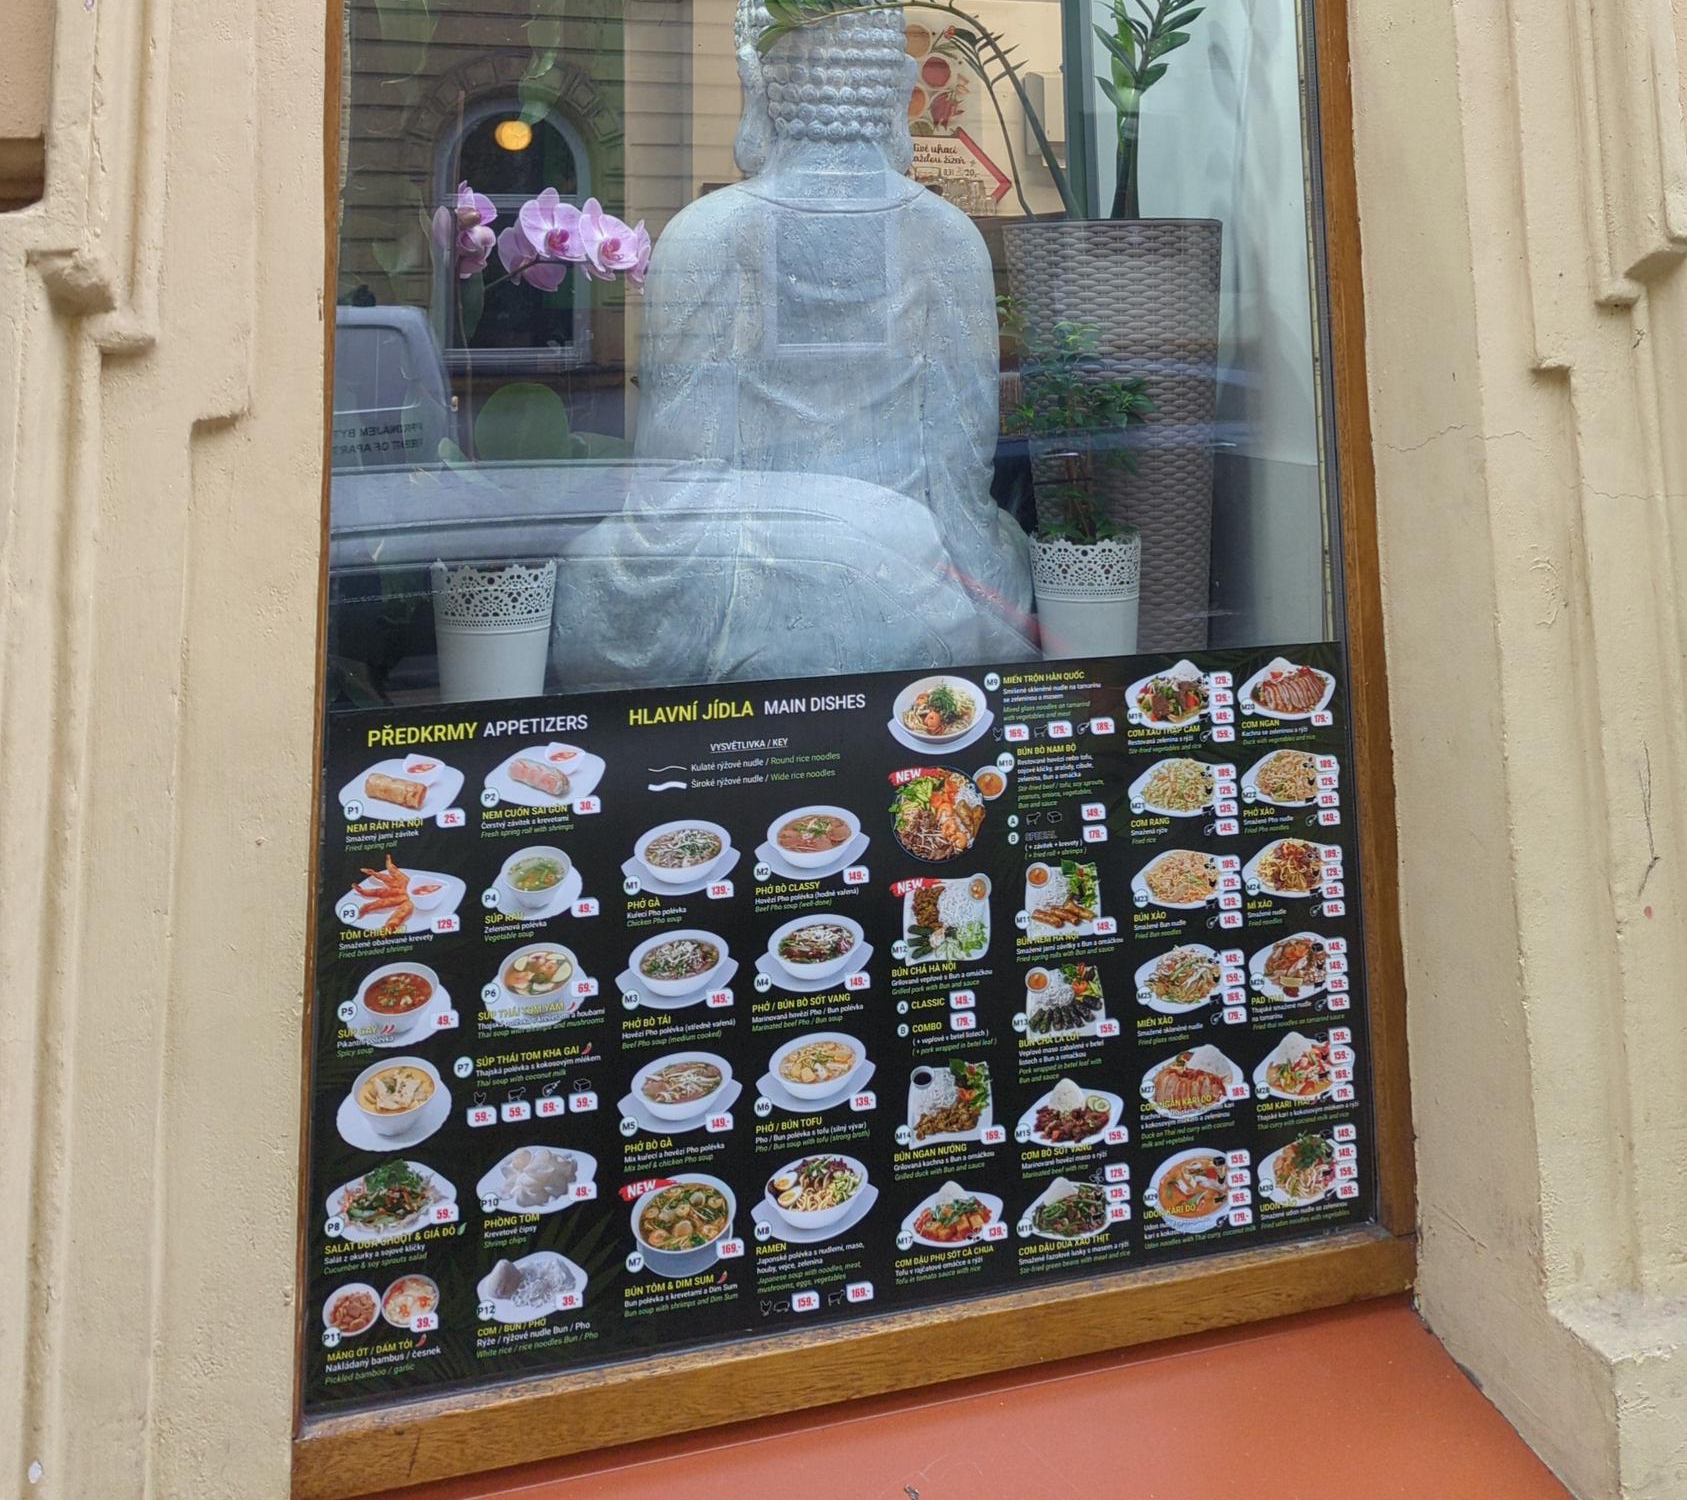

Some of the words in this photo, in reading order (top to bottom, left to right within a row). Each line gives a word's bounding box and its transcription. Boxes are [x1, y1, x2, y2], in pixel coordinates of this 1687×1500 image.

[987, 678, 998, 686] M9
[629, 701, 698, 726] HLAVNÍ
[702, 699, 754, 720] JÍDLA
[764, 698, 806, 715] MAIN
[811, 694, 866, 712] DISHES
[368, 722, 478, 748] PŘEDKRMY
[484, 714, 588, 737] APPETIZERS
[710, 739, 765, 752] VYSVĚTLIVKA
[773, 738, 788, 747] KEY
[1047, 744, 1065, 753] NAM
[691, 761, 715, 772] Kulaté
[743, 758, 763, 767] nudle
[771, 756, 794, 765] Round
[796, 754, 810, 763] rice
[811, 751, 840, 761] noodles
[691, 779, 715, 788] Široké
[743, 774, 763, 783] nudle
[771, 772, 788, 781] Wide
[790, 771, 804, 779] rice
[806, 768, 835, 778] noodles
[896, 768, 922, 783] NEW
[484, 793, 496, 802] P2
[348, 806, 359, 814] P1
[482, 811, 502, 820] NEM
[347, 823, 367, 833] NEM
[756, 868, 768, 876] M2
[625, 881, 638, 890] M1
[789, 882, 820, 892] CLASSY
[898, 879, 923, 893] NEW
[485, 893, 496, 902] P4
[343, 909, 355, 918] P3
[757, 979, 769, 987] M4
[485, 989, 496, 997] P6
[625, 994, 638, 1002] M3
[828, 993, 850, 1003] VANG
[912, 998, 945, 1009] CLASSIC
[342, 1007, 353, 1015] P5
[912, 1022, 942, 1032] COMBO
[497, 1052, 519, 1065] THÁI
[522, 1052, 541, 1063] TOM
[543, 1048, 561, 1061] KHA
[564, 1045, 579, 1057] GAI
[457, 1063, 469, 1072] P7
[757, 1103, 769, 1111] M6
[622, 1122, 635, 1130] M5
[801, 1117, 822, 1128] TOFU
[661, 1137, 672, 1148] GÀ
[913, 1148, 936, 1159] NGAN
[627, 1180, 656, 1198] NEW
[481, 1198, 499, 1207] P10
[328, 1223, 340, 1232] P8
[757, 1226, 769, 1235] M8
[424, 1227, 439, 1239] GIÁ
[756, 1243, 786, 1256] RAMEN
[629, 1258, 641, 1267] M7
[675, 1279, 693, 1291] DIM
[694, 1275, 714, 1286] SUM
[478, 1305, 496, 1314] P12
[530, 1327, 551, 1338] nudle
[554, 1325, 568, 1334] Bun
[576, 1322, 590, 1330] Pho
[323, 1334, 341, 1342] P11
[477, 1349, 497, 1358] White
[499, 1346, 512, 1354] rice
[534, 1337, 562, 1348] noodles
[564, 1335, 577, 1344] Bun
[584, 1332, 598, 1340] Pho
[326, 1358, 369, 1372] Nakládaný
[371, 1354, 404, 1365] bambus
[412, 1346, 441, 1358] česnek
[325, 1373, 354, 1385] Pickled
[355, 1368, 386, 1381] bamboo
[394, 1363, 414, 1374] garlic
